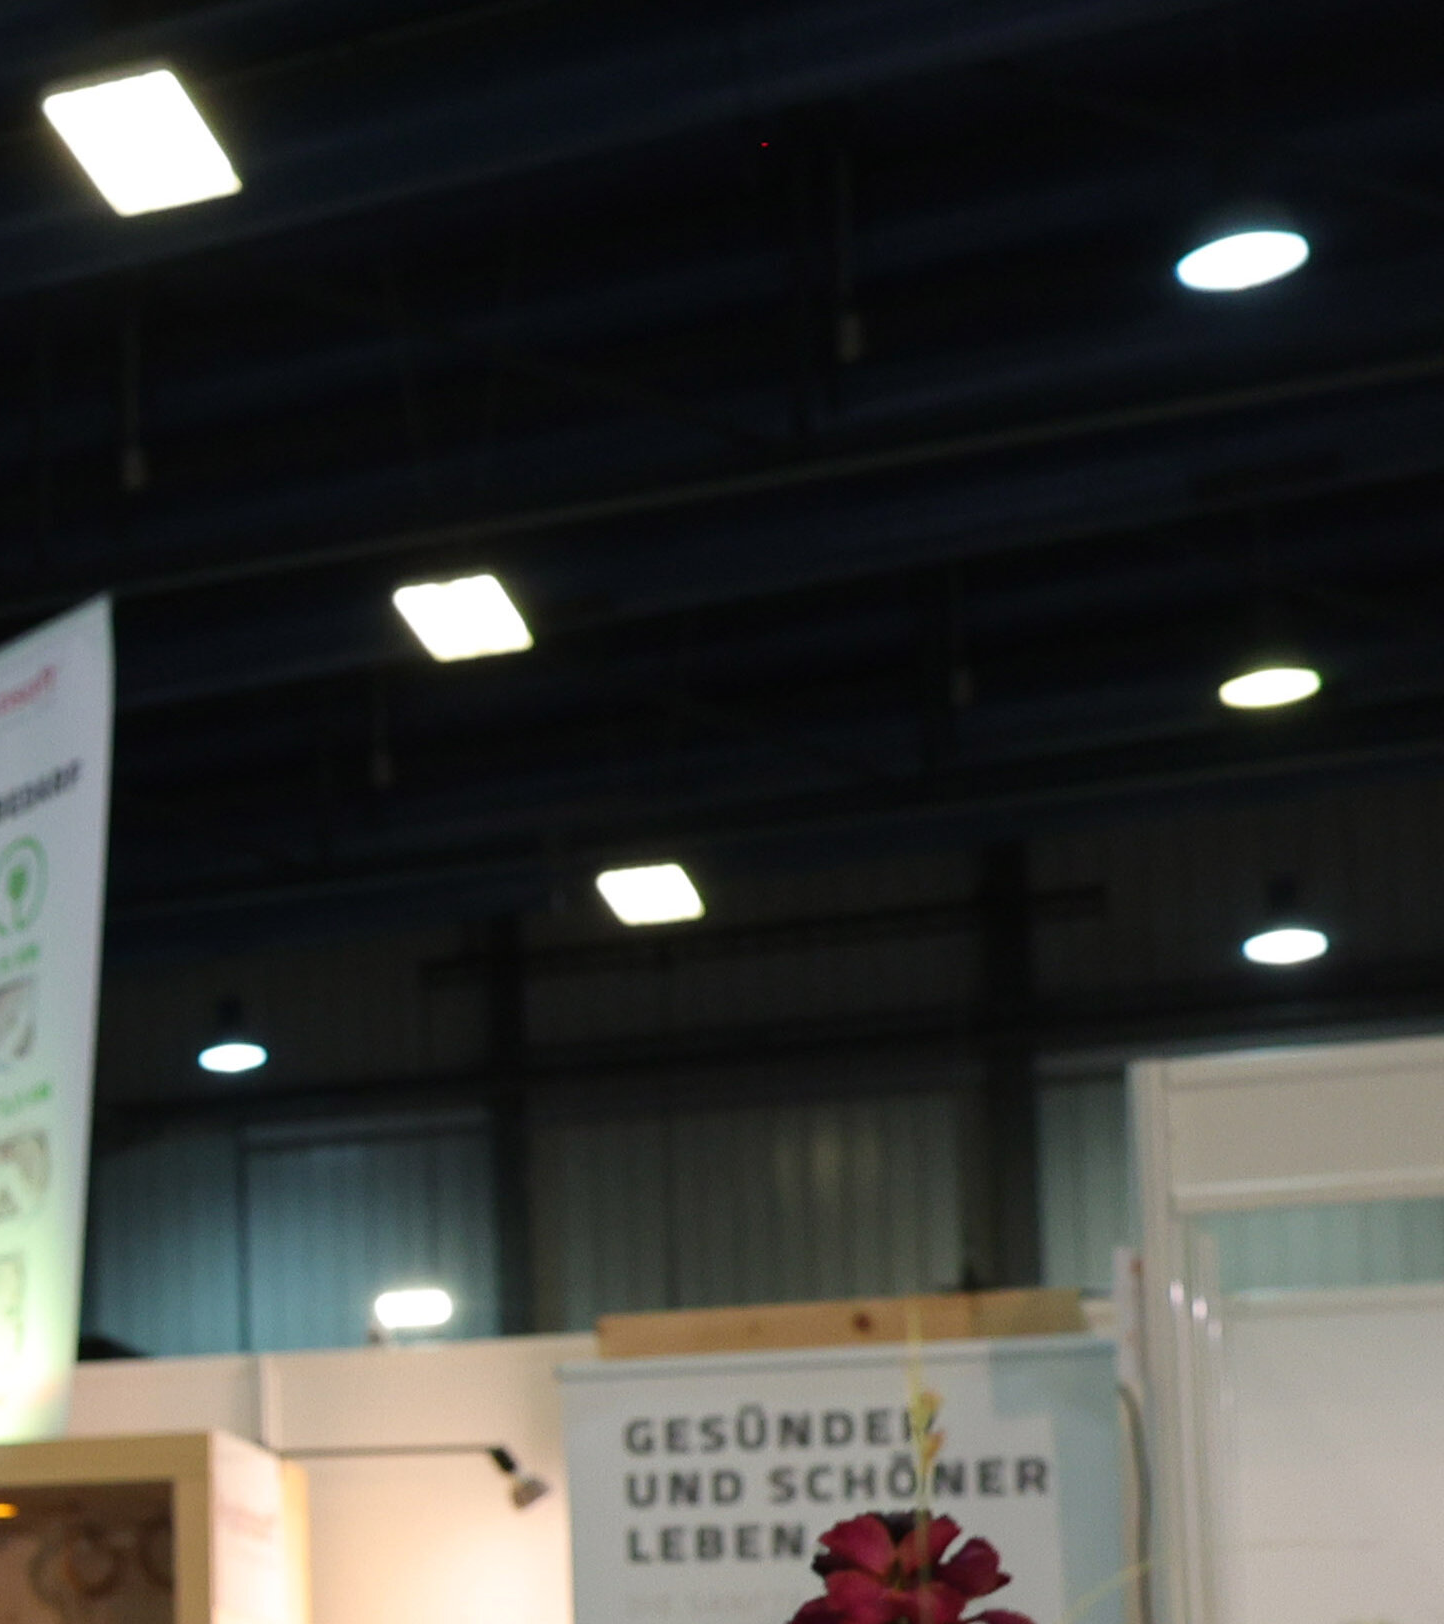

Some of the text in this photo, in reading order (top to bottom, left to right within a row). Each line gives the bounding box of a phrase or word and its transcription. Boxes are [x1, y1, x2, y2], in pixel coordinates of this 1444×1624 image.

[625, 1451, 1050, 1510] UND SCHÖNER
[626, 1522, 807, 1565] LEBEN
